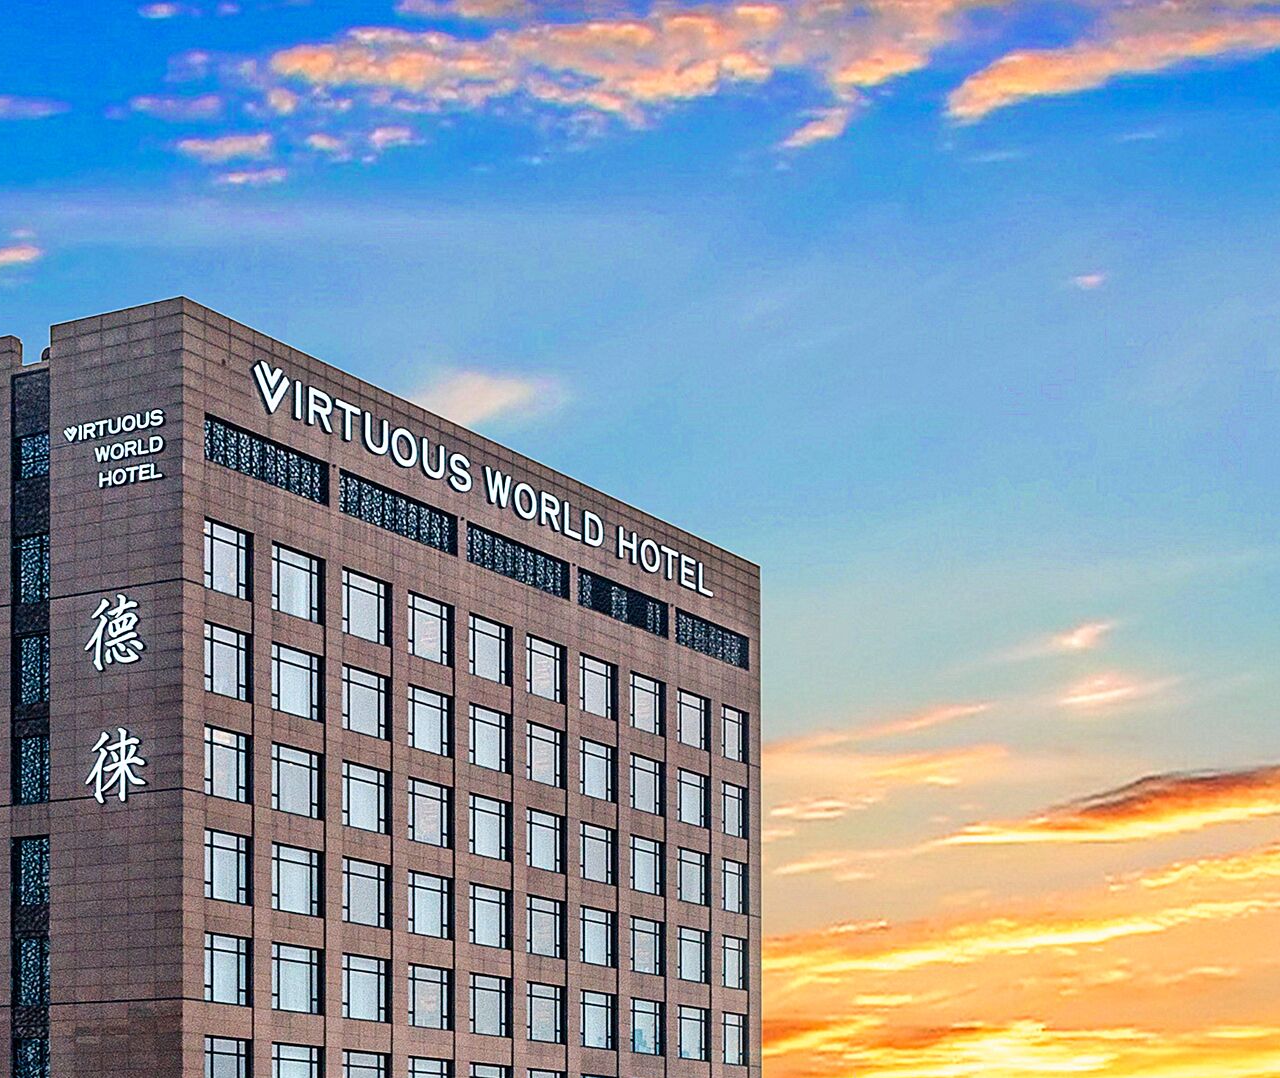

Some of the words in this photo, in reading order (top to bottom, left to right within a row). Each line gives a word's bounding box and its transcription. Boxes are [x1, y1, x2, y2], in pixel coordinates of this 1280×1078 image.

[63, 409, 164, 442] VIRTUOUS
[94, 435, 164, 463] WORLD
[98, 463, 163, 488] HOTEL
[253, 359, 473, 493] VIRTUOUS
[484, 465, 604, 548] WORLD
[617, 525, 714, 598] HOTEL
